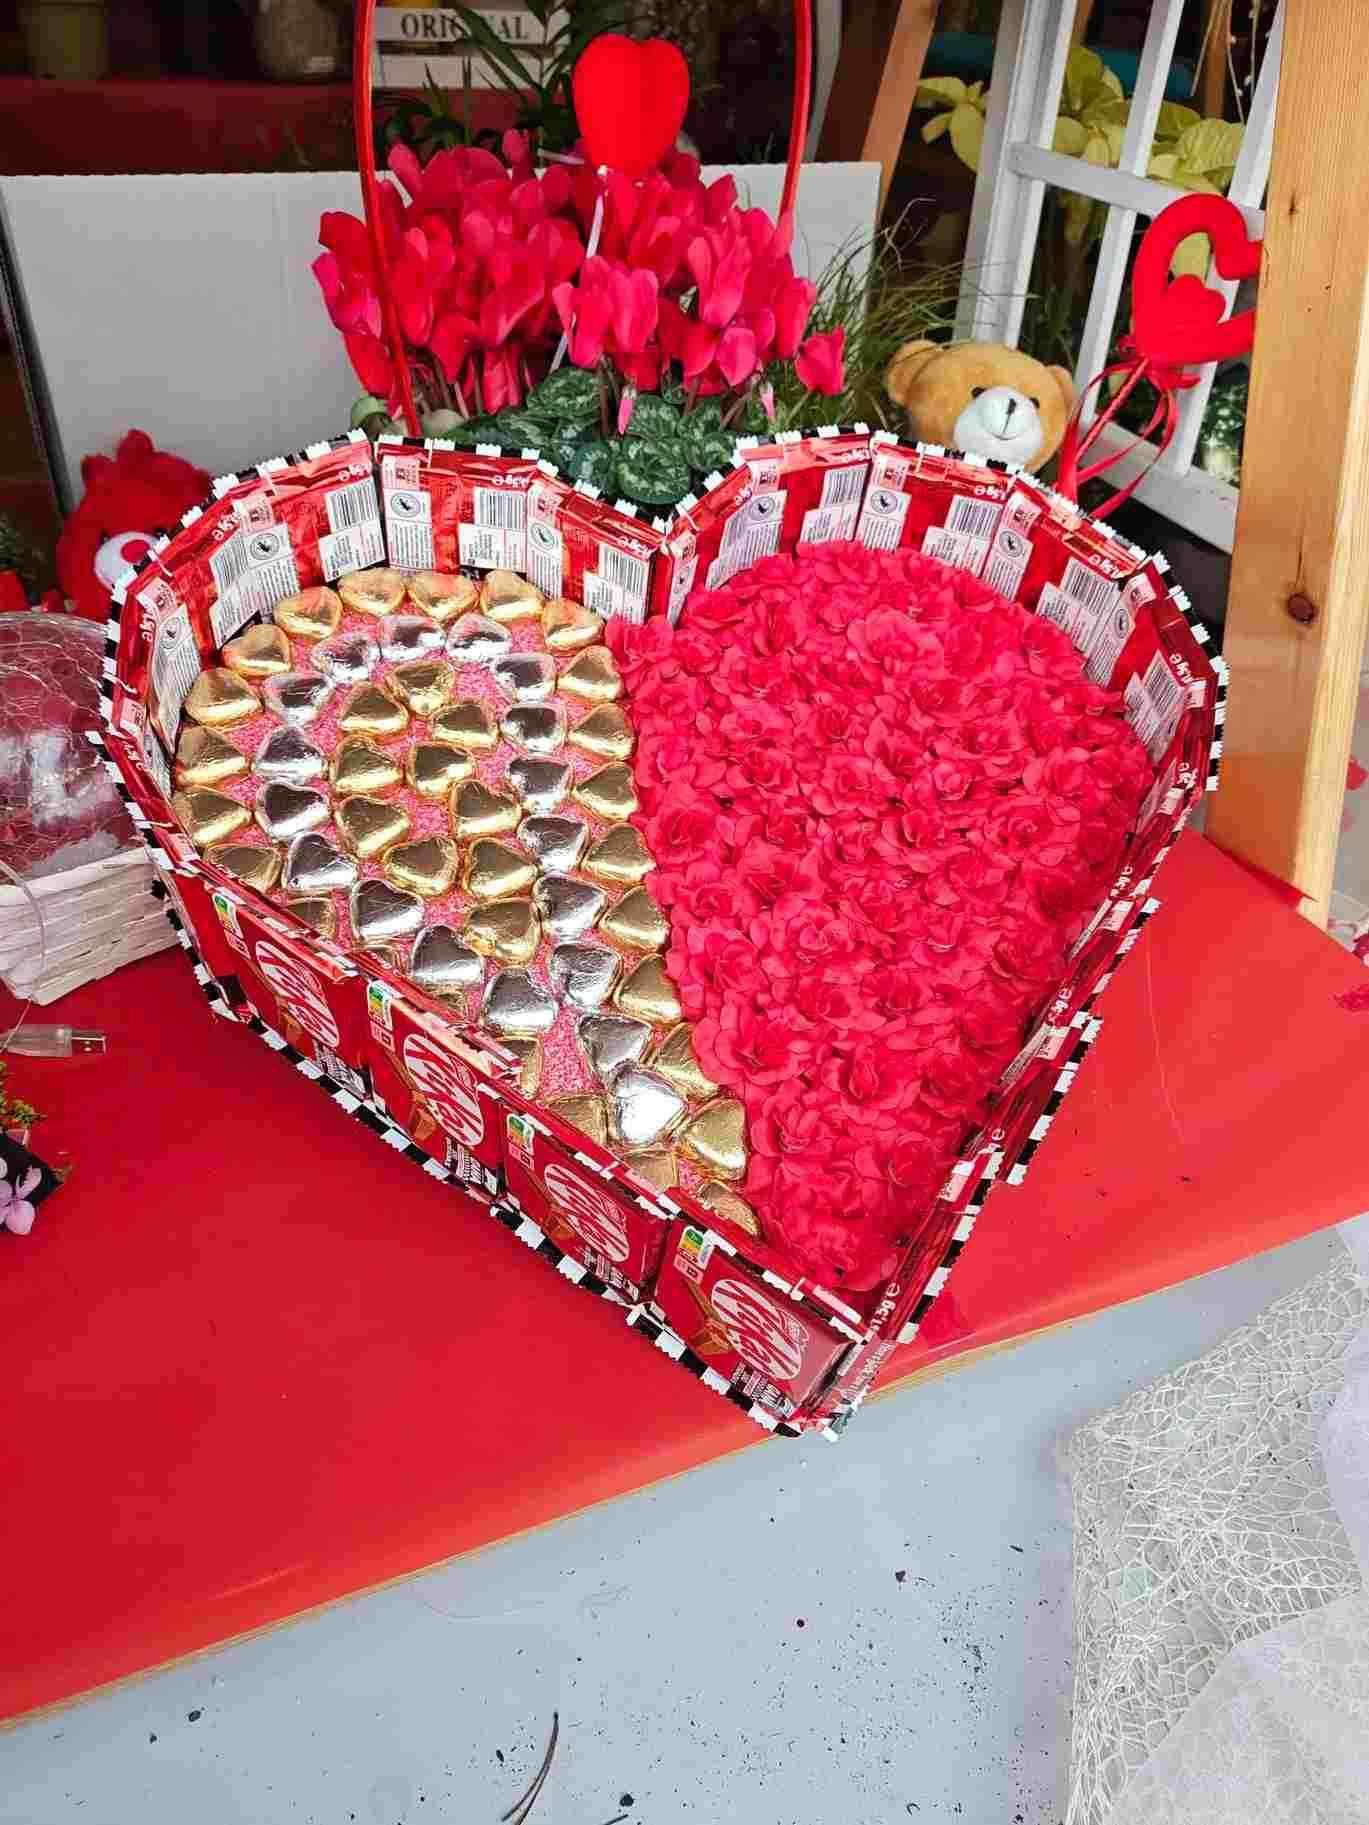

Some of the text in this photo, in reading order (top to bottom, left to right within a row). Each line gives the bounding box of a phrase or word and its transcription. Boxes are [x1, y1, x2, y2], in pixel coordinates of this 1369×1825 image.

[400, 13, 528, 40] ORIAL
[405, 1035, 484, 1145] KitKat
[546, 1165, 629, 1261] KitKat
[713, 1281, 801, 1378] KitKat
